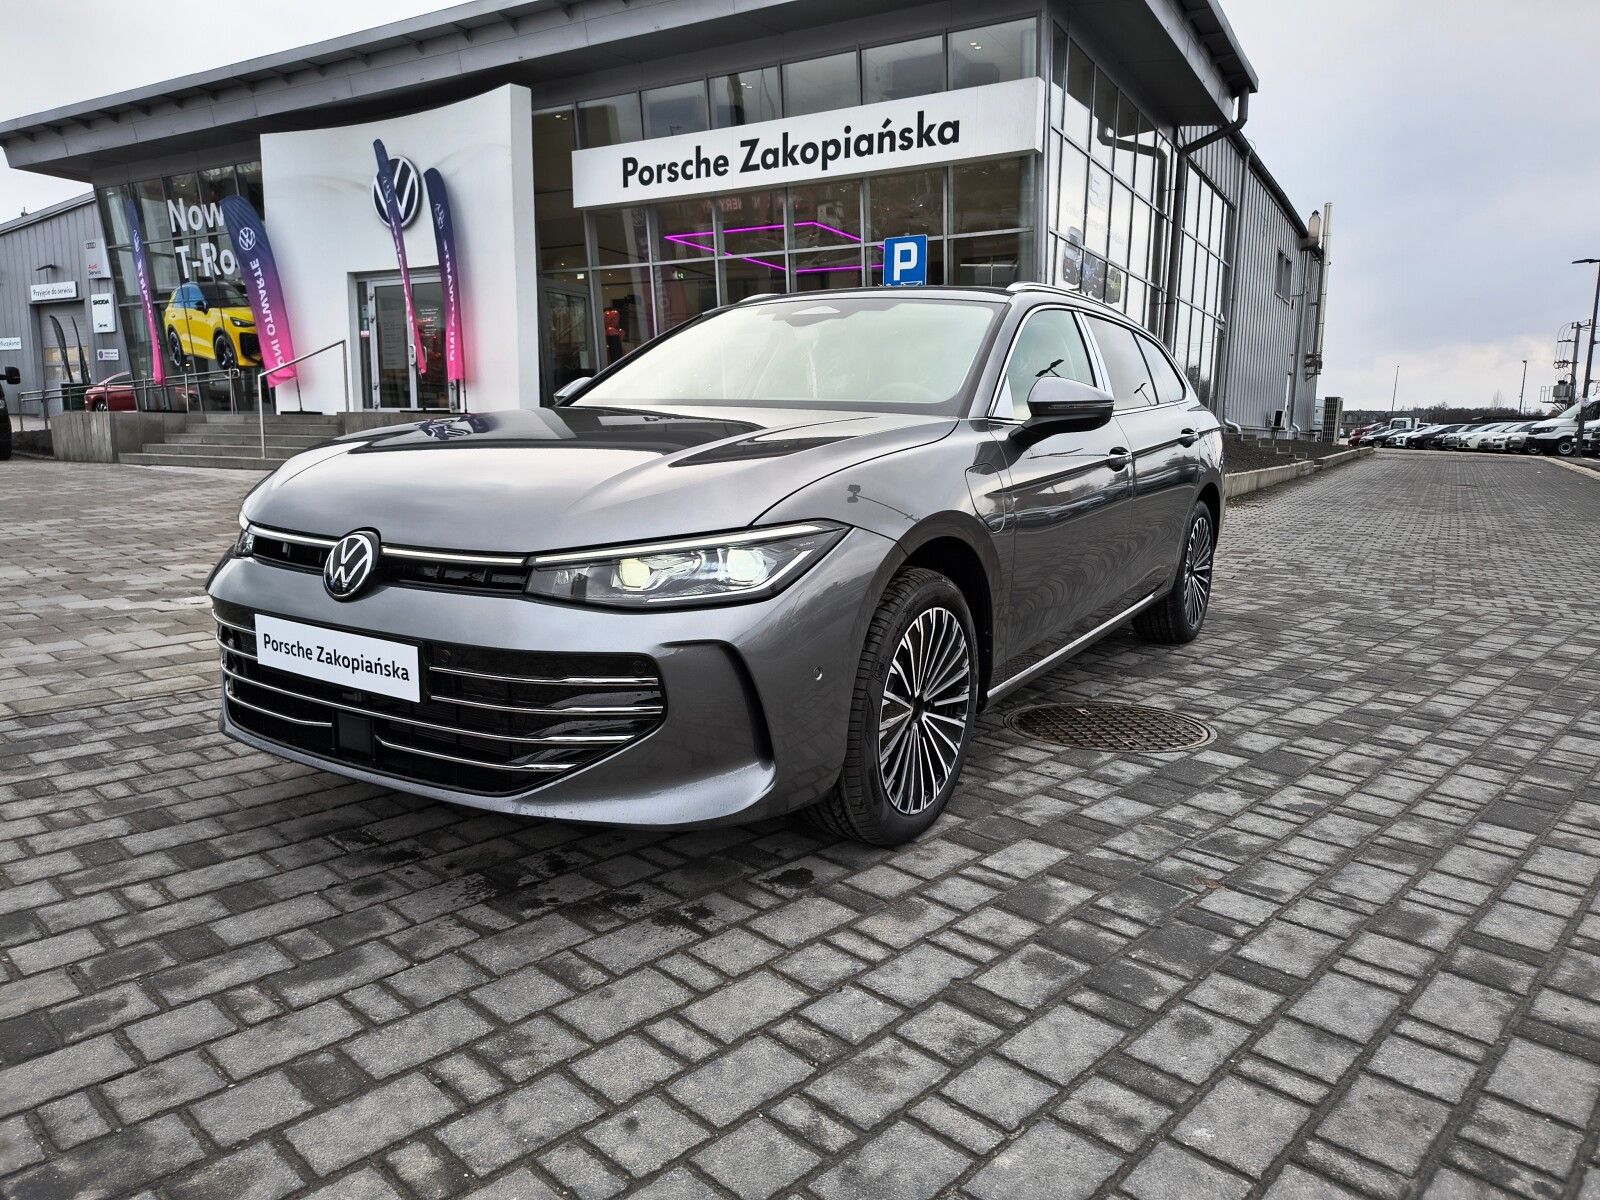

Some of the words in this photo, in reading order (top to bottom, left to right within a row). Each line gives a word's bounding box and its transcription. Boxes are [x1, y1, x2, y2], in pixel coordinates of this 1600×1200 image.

[622, 145, 730, 188] Porsche
[739, 110, 961, 174] Zakopiańska
[167, 197, 225, 233] Now
[175, 243, 240, 279] T-Ro
[893, 241, 918, 282] P
[263, 633, 313, 660] Porsche
[316, 645, 410, 682] Zakopiańska
